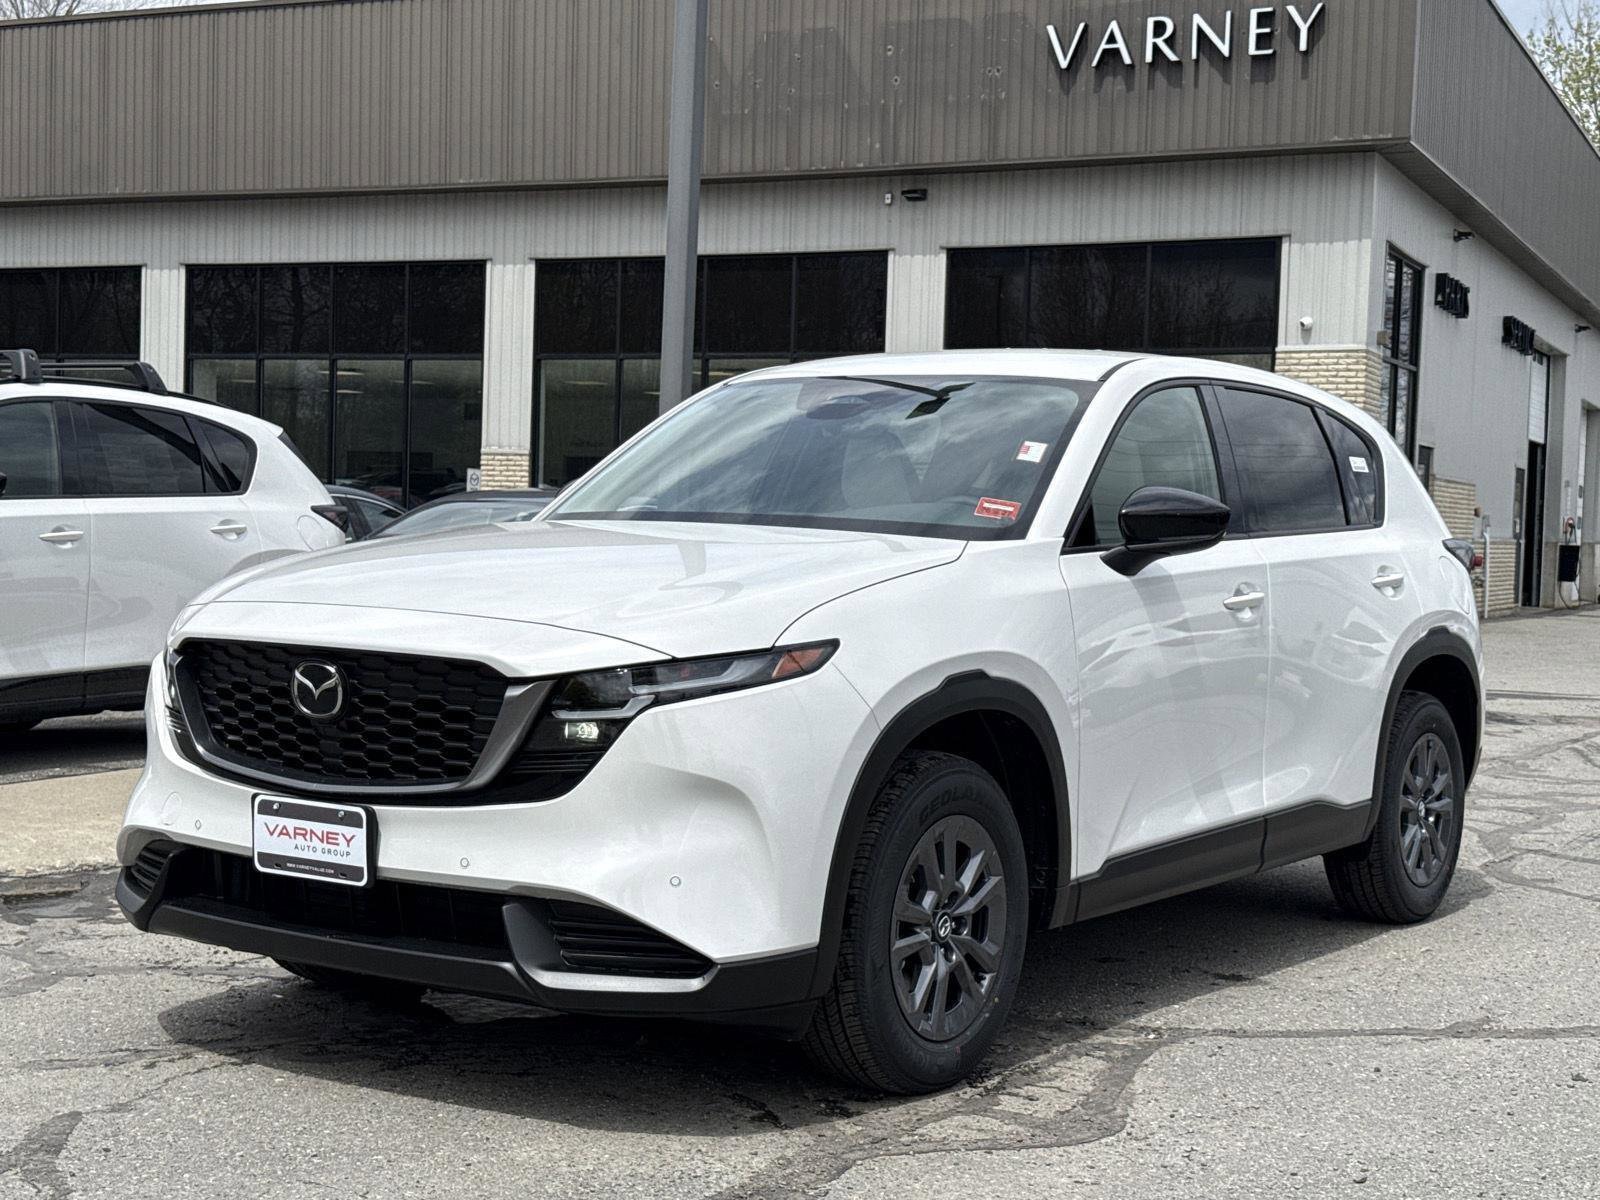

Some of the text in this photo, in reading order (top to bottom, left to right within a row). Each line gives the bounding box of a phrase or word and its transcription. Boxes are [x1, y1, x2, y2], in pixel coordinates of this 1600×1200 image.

[1046, 2, 1325, 70] VARNEY
[264, 822, 356, 848] VARNEY
[294, 843, 351, 858] AUTO GROUP
